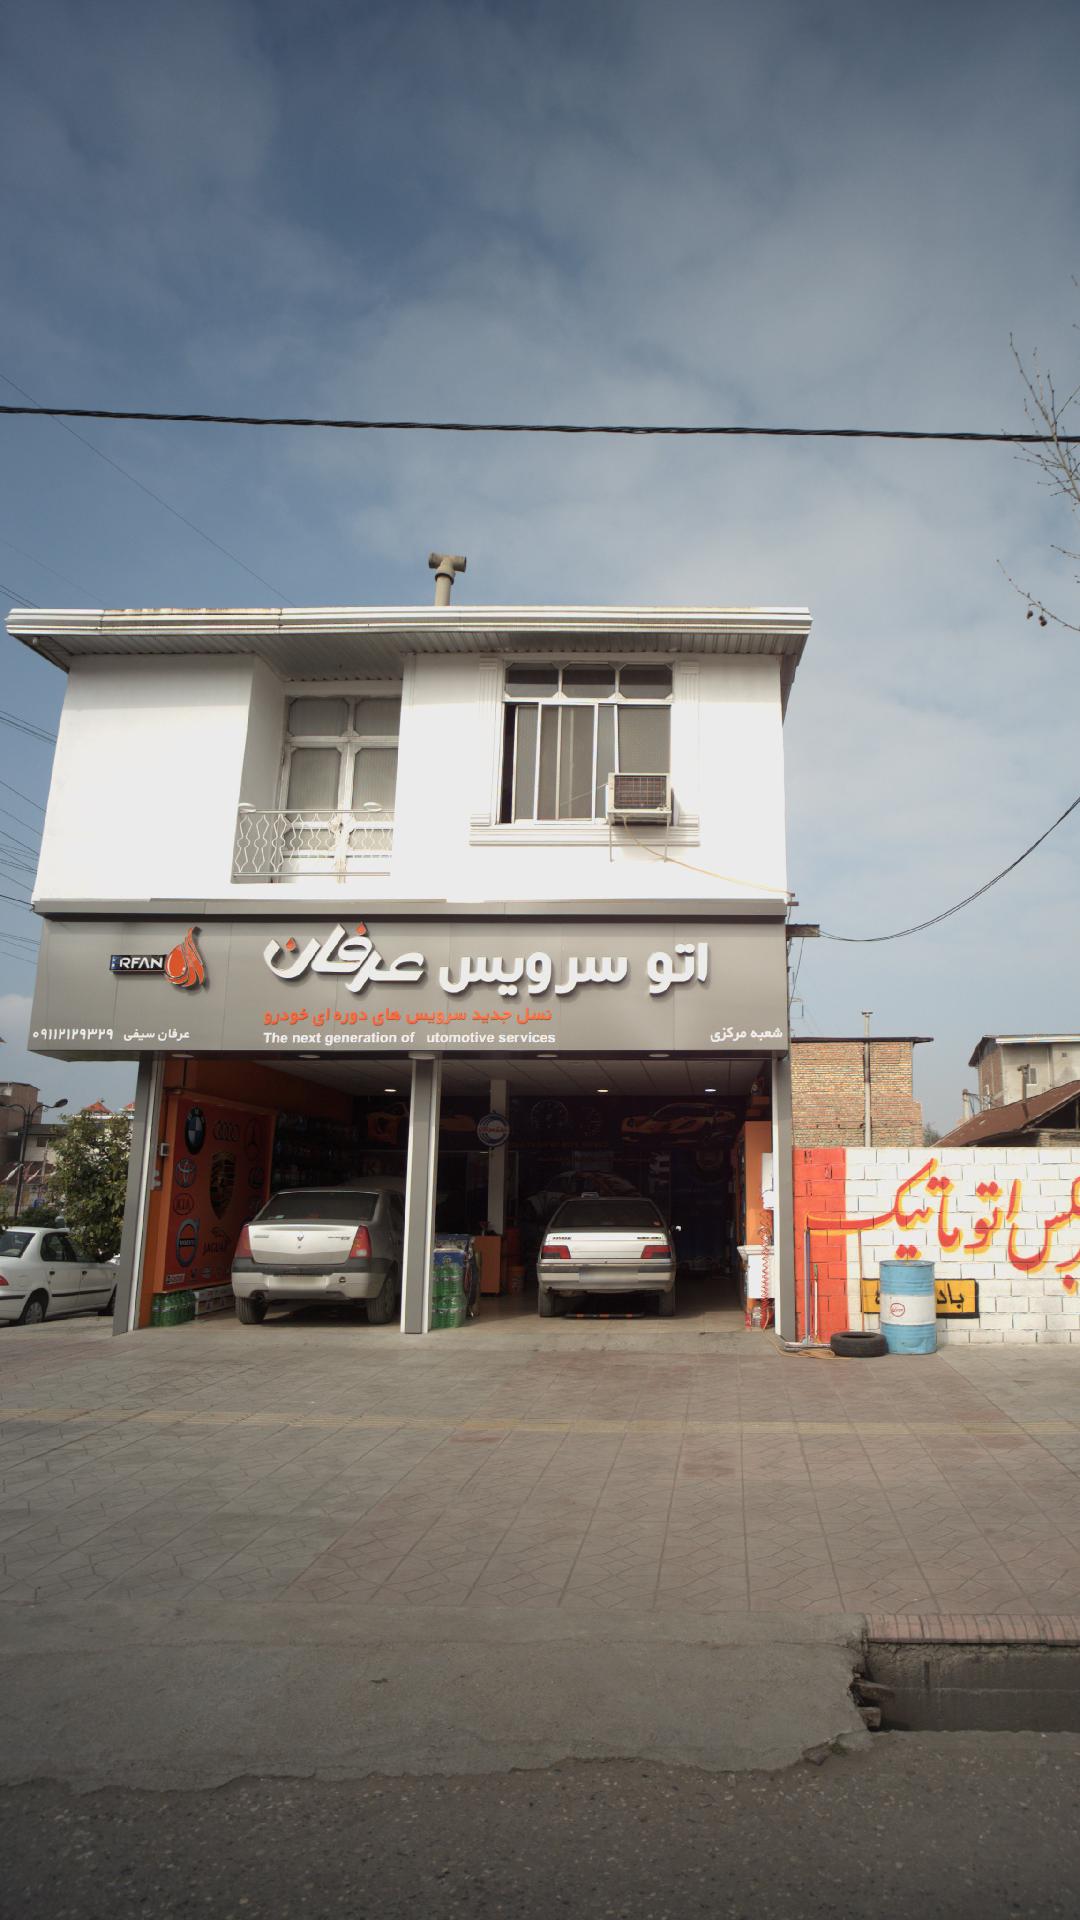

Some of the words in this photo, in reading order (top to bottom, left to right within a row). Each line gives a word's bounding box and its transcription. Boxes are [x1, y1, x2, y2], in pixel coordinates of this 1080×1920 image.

[263, 921, 425, 993] عرفان
[439, 951, 628, 996] سرویس
[646, 942, 708, 994] اتو
[263, 1008, 309, 1025] خودرو
[312, 1008, 331, 1026] ای
[333, 1010, 367, 1025] دوره
[372, 1008, 401, 1026] های
[405, 1011, 467, 1024] سرویس
[472, 1010, 512, 1024] جدید
[516, 1008, 552, 1024] نسل
[123, 1029, 155, 1041] سیفی
[157, 1029, 190, 1041] عرفان
[263, 1032, 288, 1043] The
[292, 1032, 321, 1043] next
[325, 1032, 397, 1046] generation
[401, 1032, 416, 1043] of
[498, 1032, 556, 1043] services
[710, 1027, 747, 1042] مرکزی
[750, 1027, 783, 1041] شعبه
